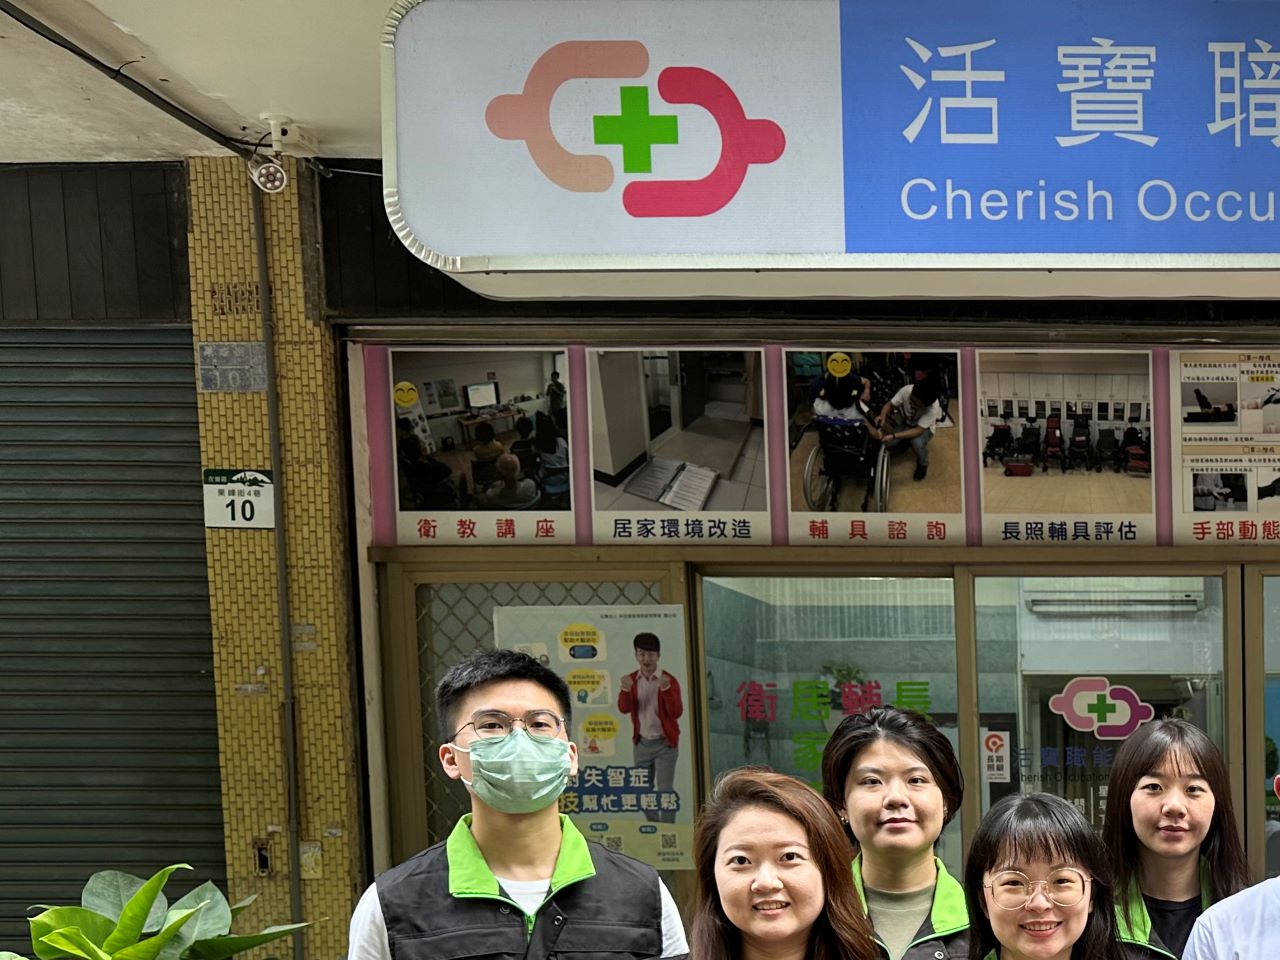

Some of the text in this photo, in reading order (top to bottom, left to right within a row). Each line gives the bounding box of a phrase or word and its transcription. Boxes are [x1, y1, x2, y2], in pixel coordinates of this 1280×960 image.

[899, 178, 1114, 222] Cherish
[225, 499, 255, 522] 10
[416, 517, 557, 540] 衛教講座
[612, 517, 753, 540] 居家環境改造
[807, 518, 947, 541] 輔具諮詢
[1001, 520, 1138, 542] 長照輔具評估
